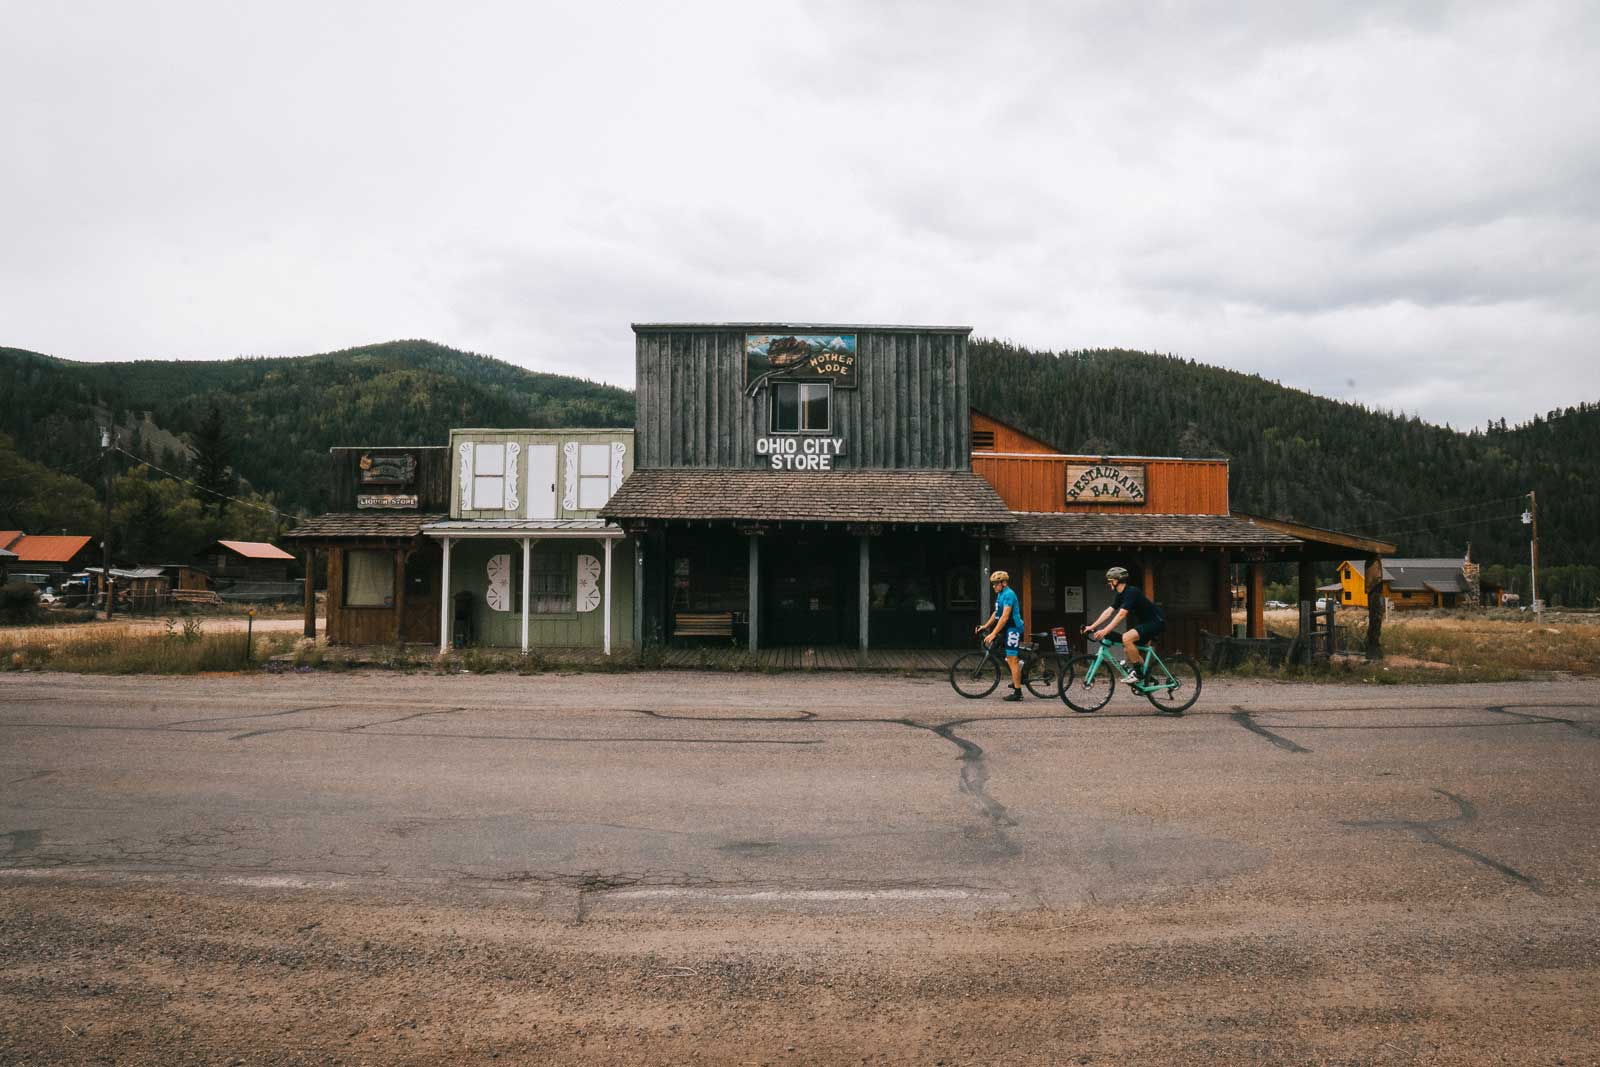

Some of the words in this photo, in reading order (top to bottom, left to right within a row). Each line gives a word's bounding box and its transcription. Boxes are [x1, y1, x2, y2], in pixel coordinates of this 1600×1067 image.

[809, 353, 854, 367] MOTHER
[817, 364, 848, 375] LODE
[756, 438, 797, 454] OHIO
[803, 438, 843, 454] CITY
[771, 454, 831, 470] STORE
[1067, 466, 1144, 500] RESTAURANT
[1090, 482, 1121, 498] BAR
